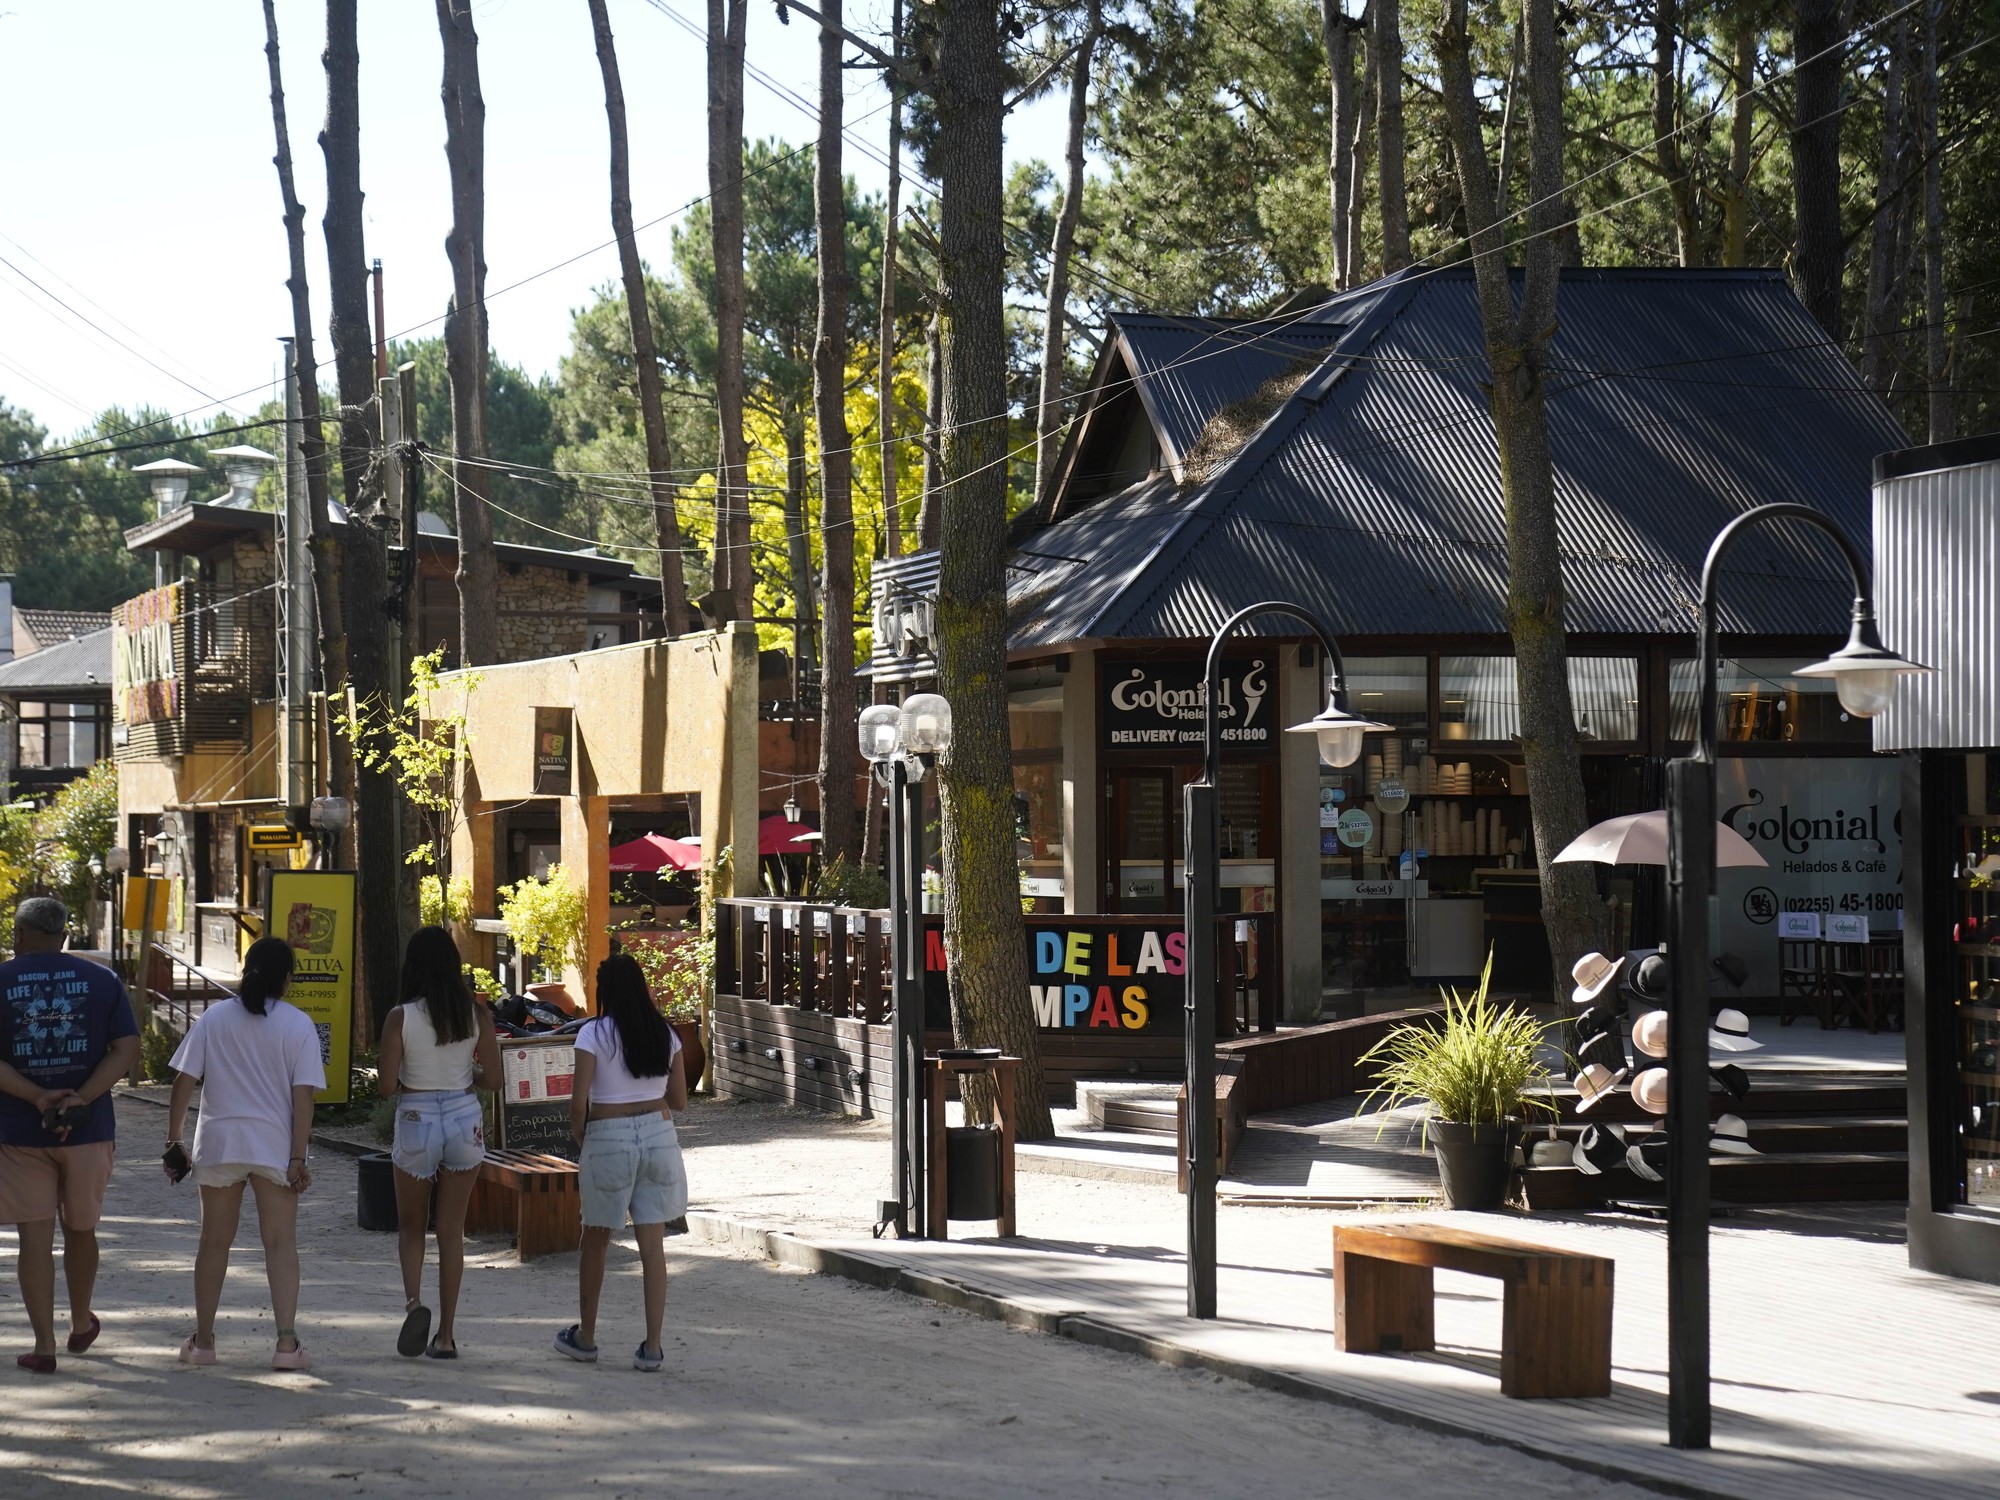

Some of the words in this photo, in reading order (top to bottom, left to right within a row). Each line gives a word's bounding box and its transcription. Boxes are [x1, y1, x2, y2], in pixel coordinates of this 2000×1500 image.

[126, 621, 175, 688] NATIVA
[1111, 668, 1237, 718] Colonil
[1179, 709, 1229, 720] Helaos
[1111, 729, 1177, 743] DELIVERY
[1178, 731, 1205, 743] (0225
[1220, 728, 1268, 741] 451800
[538, 756, 568, 764] NATIVA
[1720, 788, 1886, 855] Colonial
[1783, 860, 1838, 873] Helados
[1841, 860, 1852, 873] &
[1855, 859, 1887, 873] Café
[1356, 882, 1386, 895] Colonial
[1784, 895, 1835, 913] (02255)
[1839, 893, 1903, 912] 45-1800
[1036, 931, 1093, 976] DE
[1108, 931, 1185, 976] LAS
[294, 959, 344, 972] ATIVA
[53, 970, 76, 980] JEANS
[7, 985, 31, 1000] LIFE
[66, 982, 89, 994] LIFE
[287, 990, 337, 998] 2255-479955
[1030, 985, 1149, 1030] MPAS
[13, 1043, 32, 1056] LIFE
[67, 1040, 87, 1053] LIFE
[510, 1129, 543, 1142] Guiso
